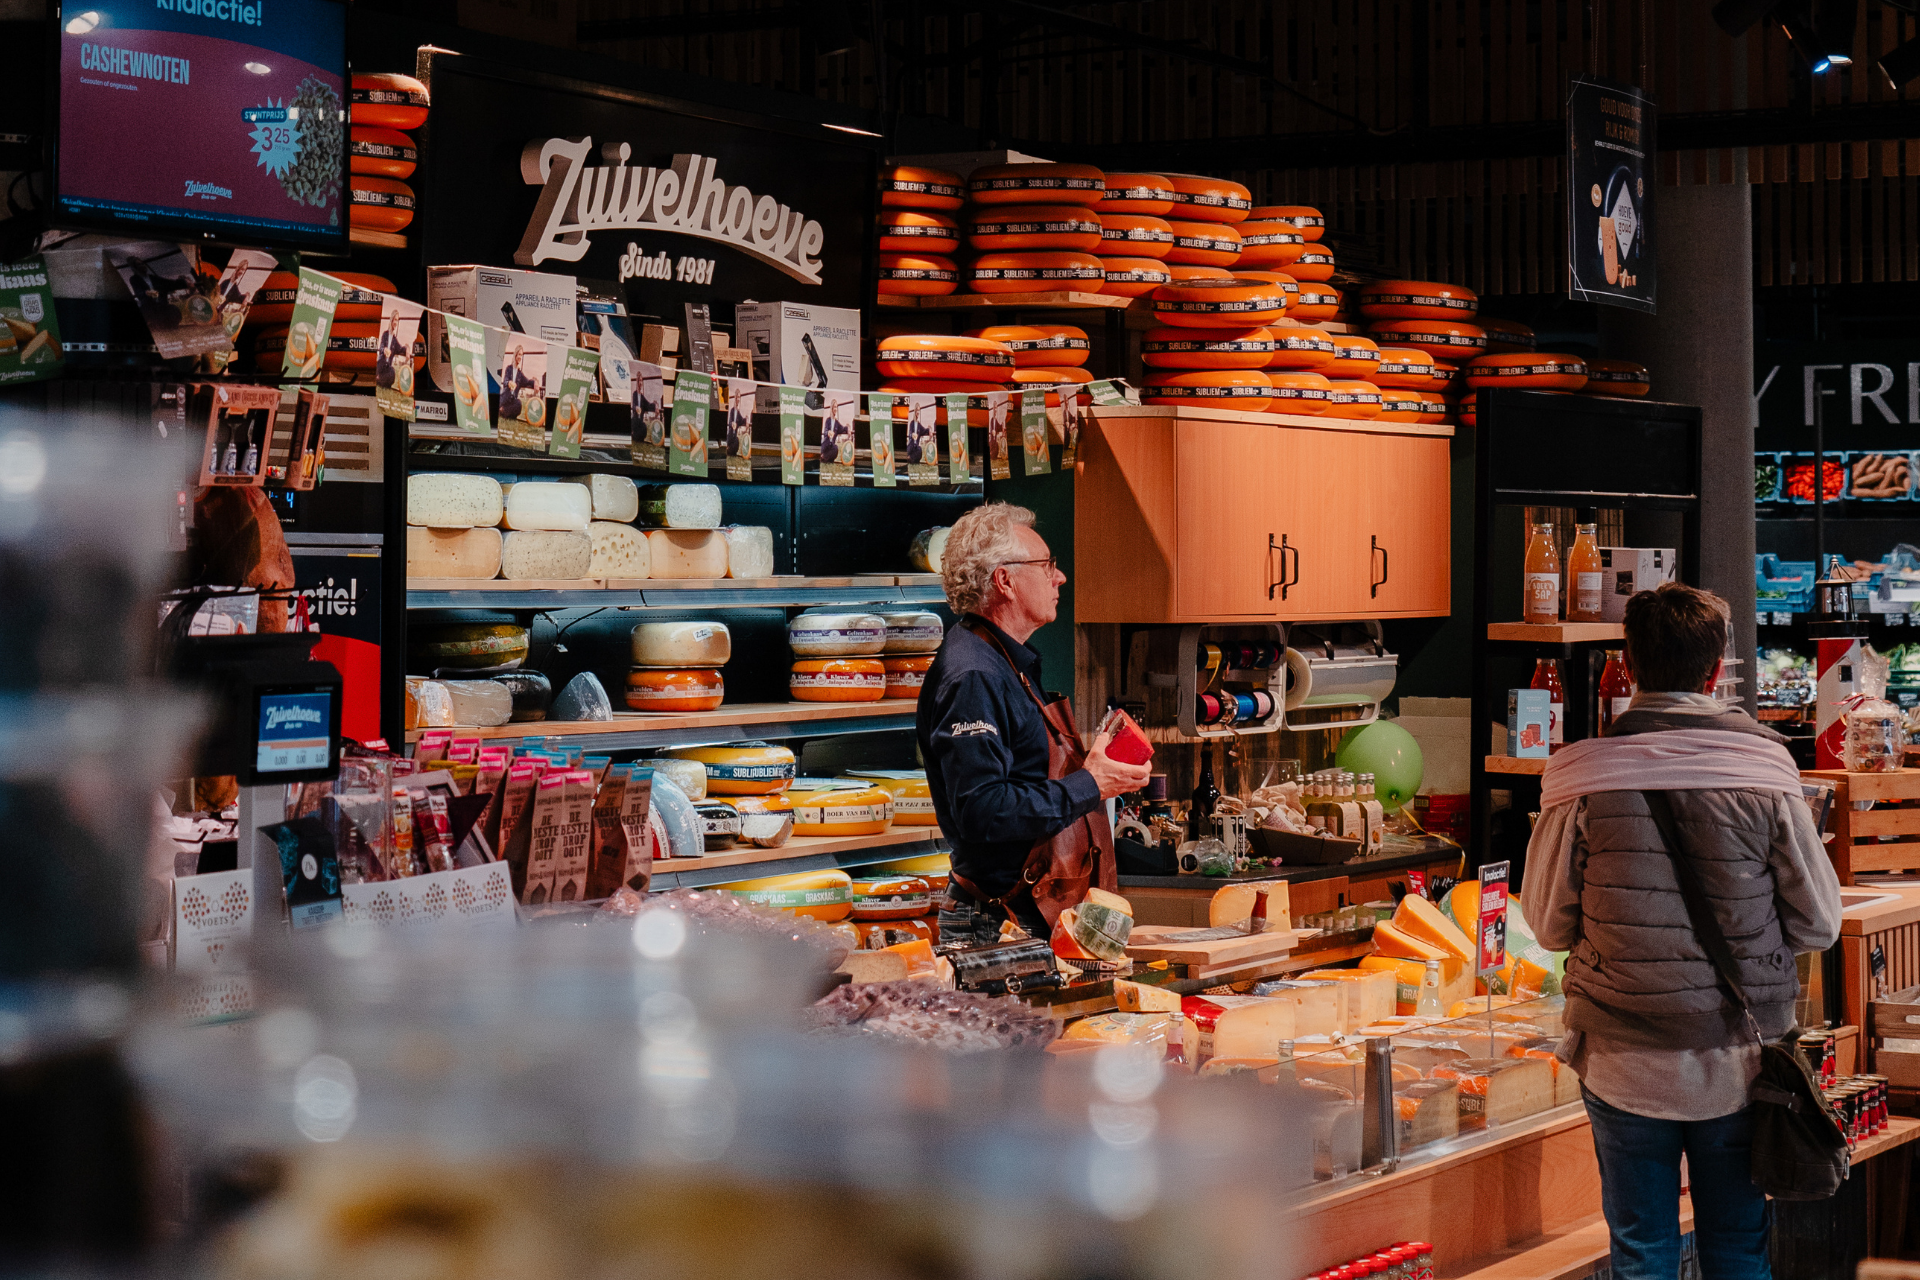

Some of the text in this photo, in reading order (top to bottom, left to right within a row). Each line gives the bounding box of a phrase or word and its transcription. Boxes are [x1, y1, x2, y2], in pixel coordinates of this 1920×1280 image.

[81, 42, 190, 85] CASHEWNOTEN
[369, 91, 398, 102] SUBLIEM
[352, 189, 382, 202] SUBLIEM
[518, 136, 824, 284] Zuivelhoeve
[1180, 238, 1204, 247] SUBLIEM
[619, 242, 715, 285] Sinds 1981
[1004, 269, 1029, 278] SUBLIEM
[1107, 271, 1131, 281] SUBLIEM
[266, 291, 295, 301] SUBLIEM
[1182, 302, 1206, 311] SUBLIEM
[1219, 302, 1245, 311] SUBLIEM
[908, 351, 933, 359] SUBLIEM
[1196, 387, 1221, 396] SUBLIEM
[421, 406, 447, 415] MAFIROL
[1535, 589, 1551, 600] SAP
[265, 705, 321, 729] Zuivelhoeve
[631, 803, 641, 815] DE
[541, 815, 553, 826] DE
[569, 811, 581, 823] DE
[561, 823, 589, 836] BESTE
[563, 834, 586, 847] DROP
[563, 846, 584, 858] OOIT
[805, 891, 835, 903] GRASKAAS
[470, 904, 493, 914] VOETS
[202, 917, 229, 926] VOETS
